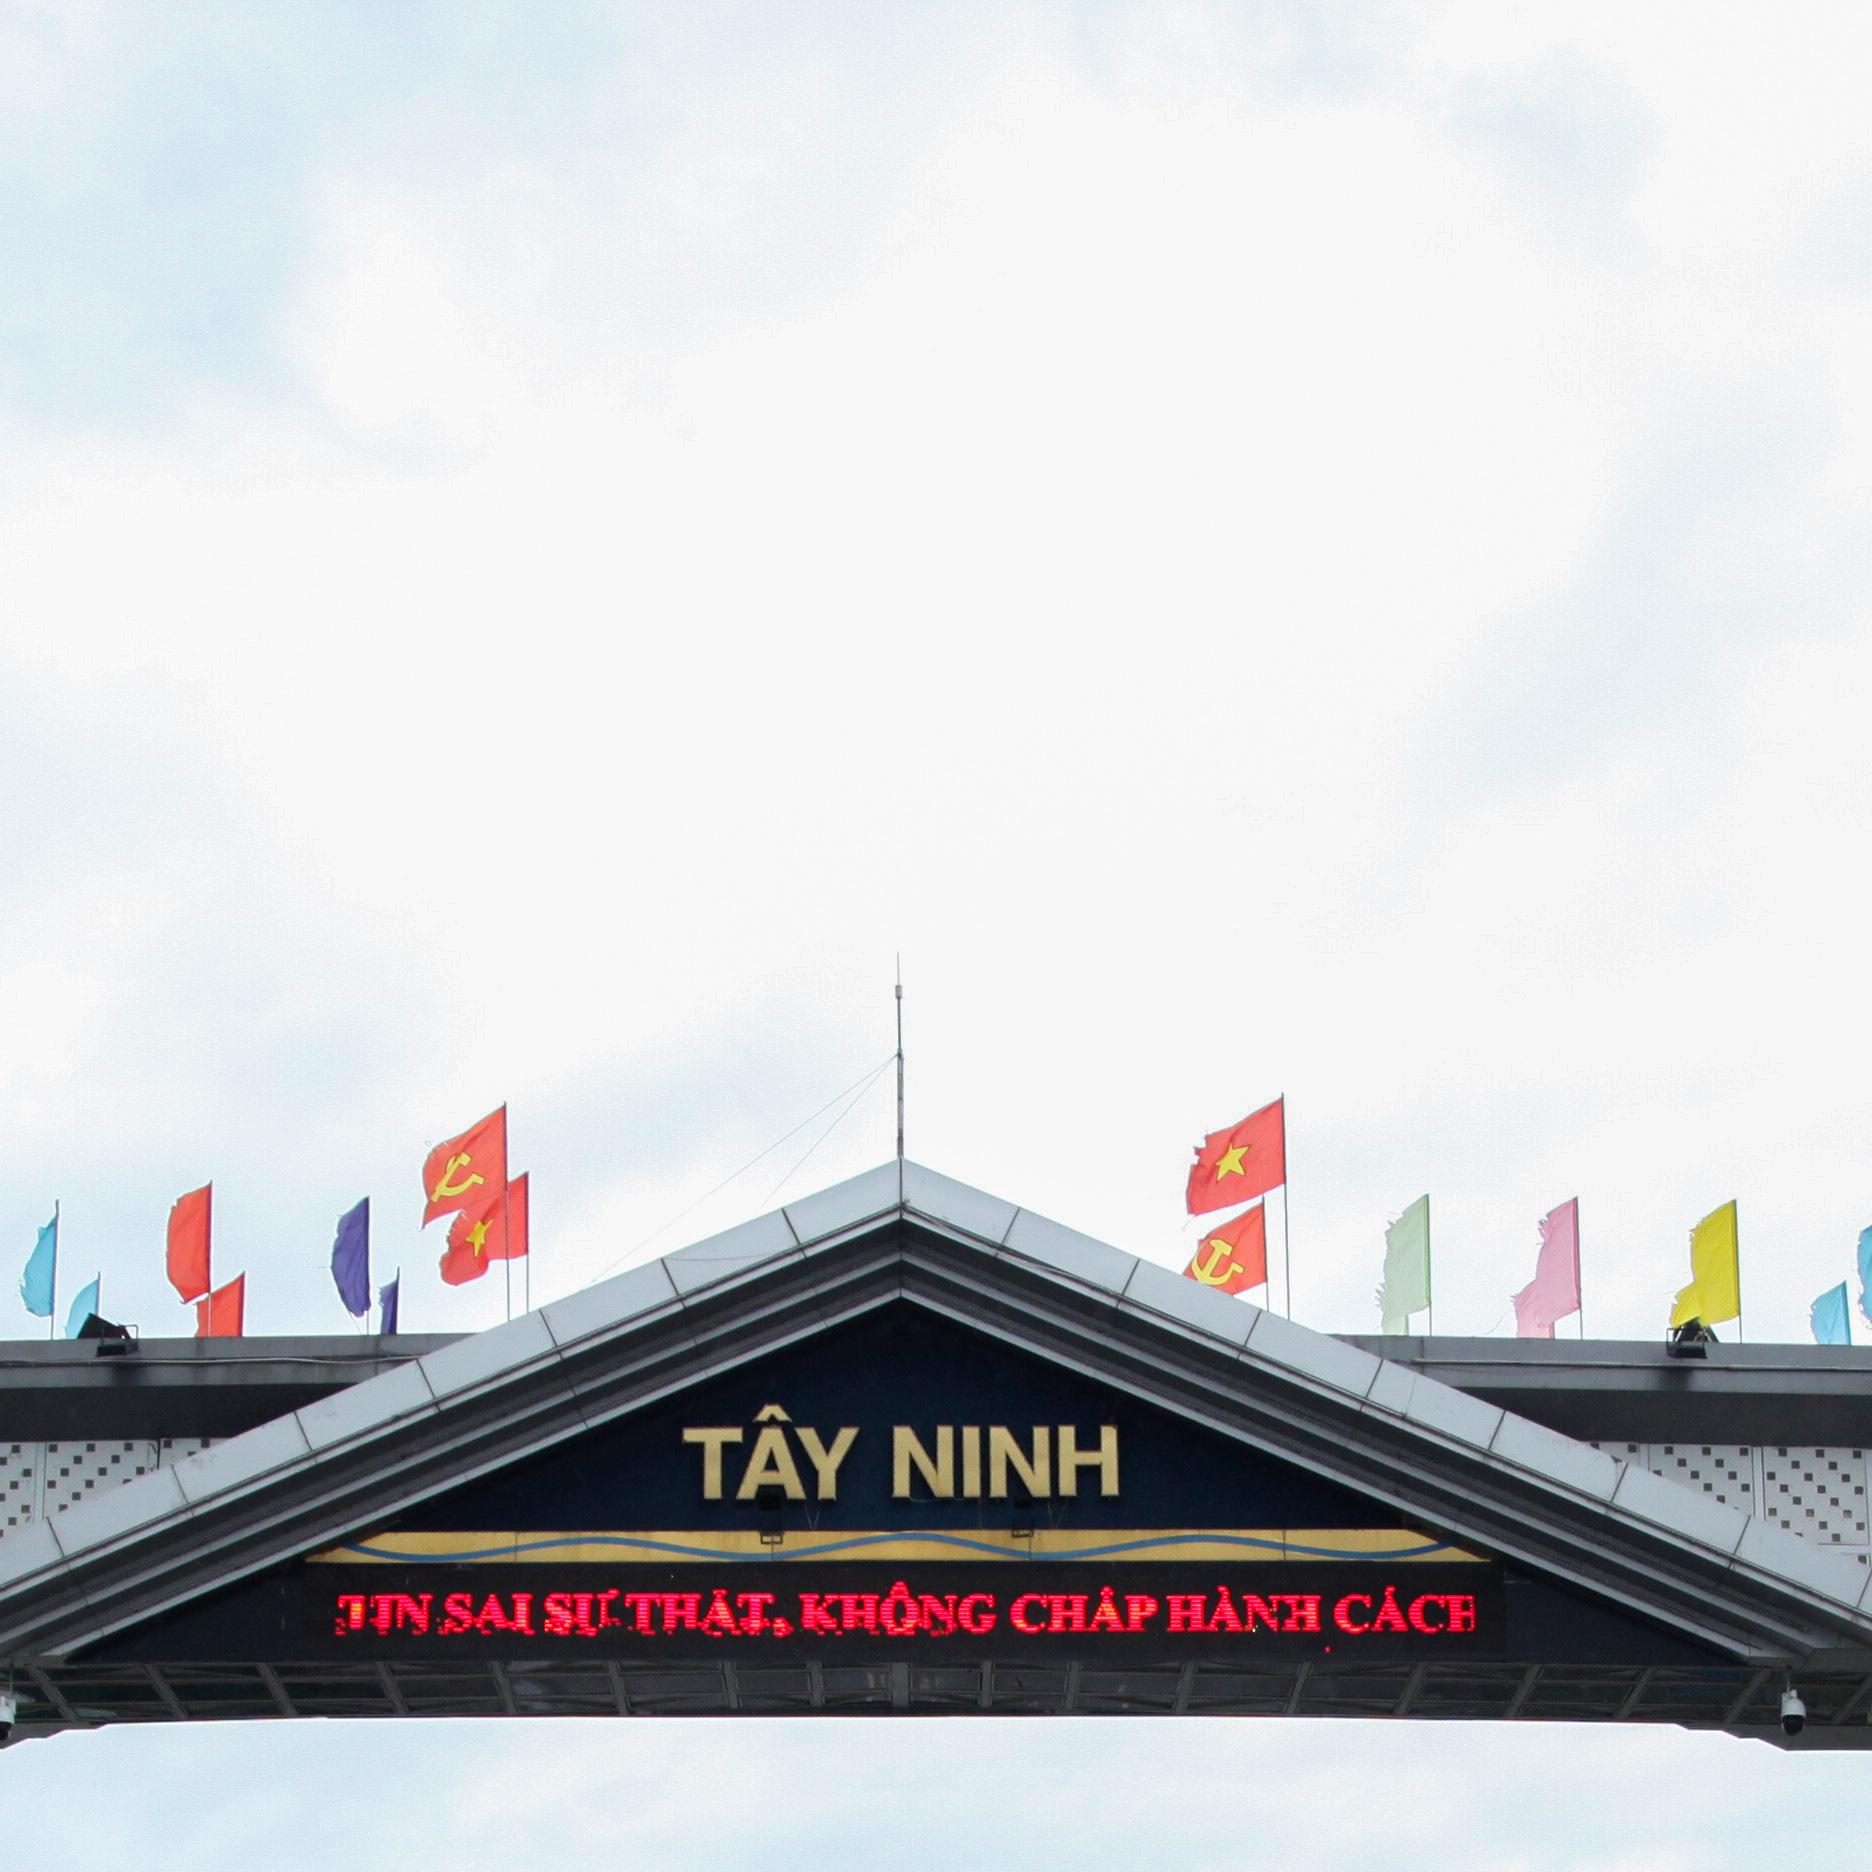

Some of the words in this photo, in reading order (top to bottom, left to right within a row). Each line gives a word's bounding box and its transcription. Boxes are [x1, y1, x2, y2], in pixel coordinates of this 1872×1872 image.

[682, 1403, 860, 1500] TÂY
[892, 1424, 1119, 1498] NINH
[437, 1593, 535, 1636] SAI
[798, 1581, 997, 1637] KHÔNG
[1166, 1585, 1322, 1632] HÀNH
[1332, 1585, 1476, 1635] CÁCH
